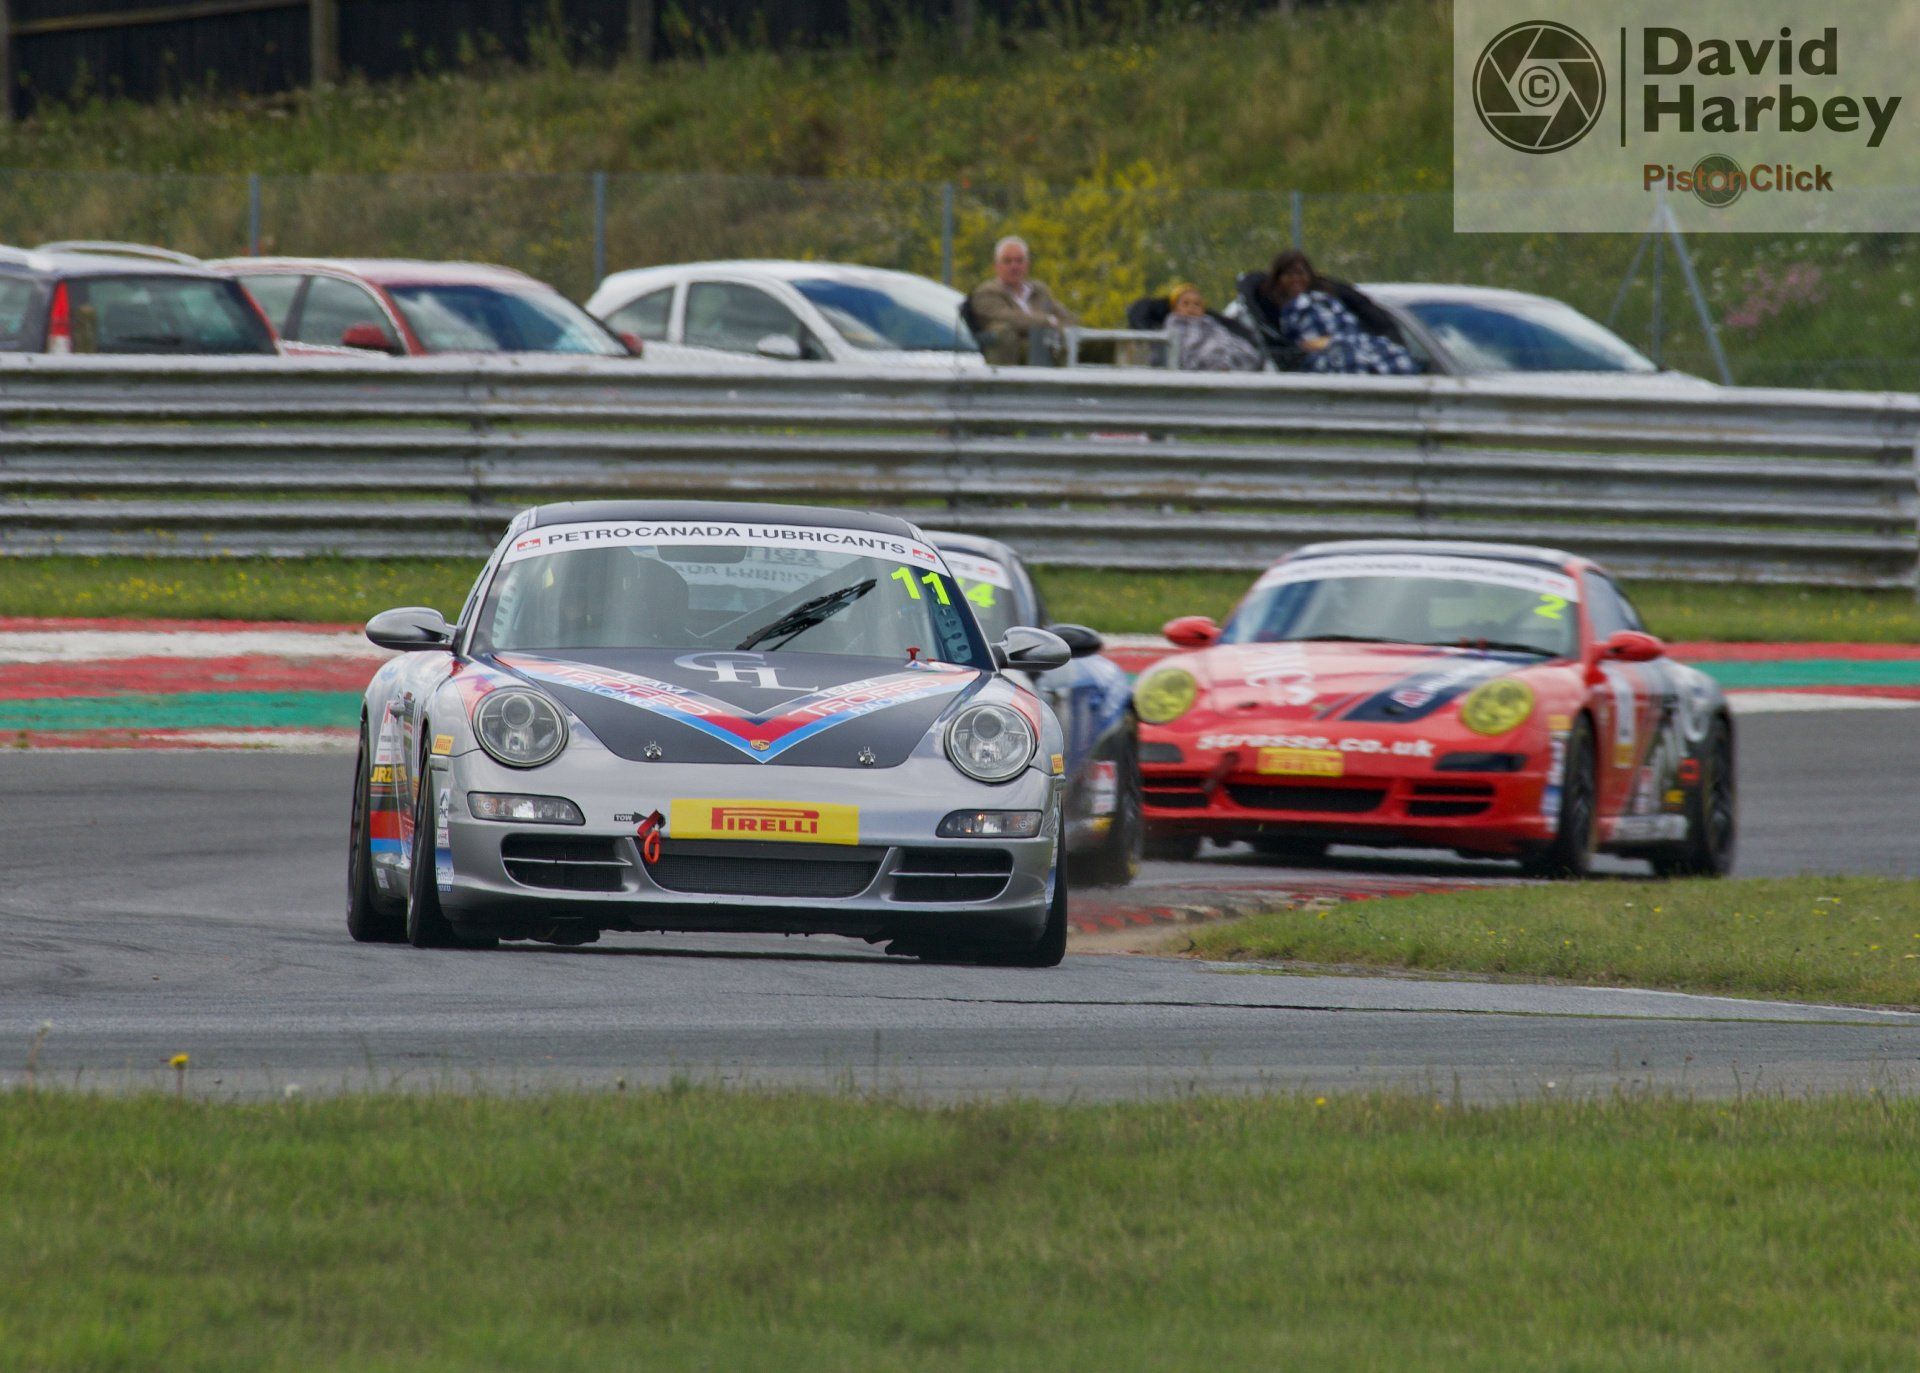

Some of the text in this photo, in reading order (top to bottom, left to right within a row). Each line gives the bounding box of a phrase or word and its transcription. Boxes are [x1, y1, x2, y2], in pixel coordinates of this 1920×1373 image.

[748, 528, 906, 554] LUBRICANTS
[891, 567, 951, 606] 11
[1533, 592, 1569, 620] 2
[612, 671, 691, 695] TEAM
[811, 680, 879, 699] TEAM
[615, 814, 633, 822] TOW
[711, 806, 820, 834] PIRELLI
